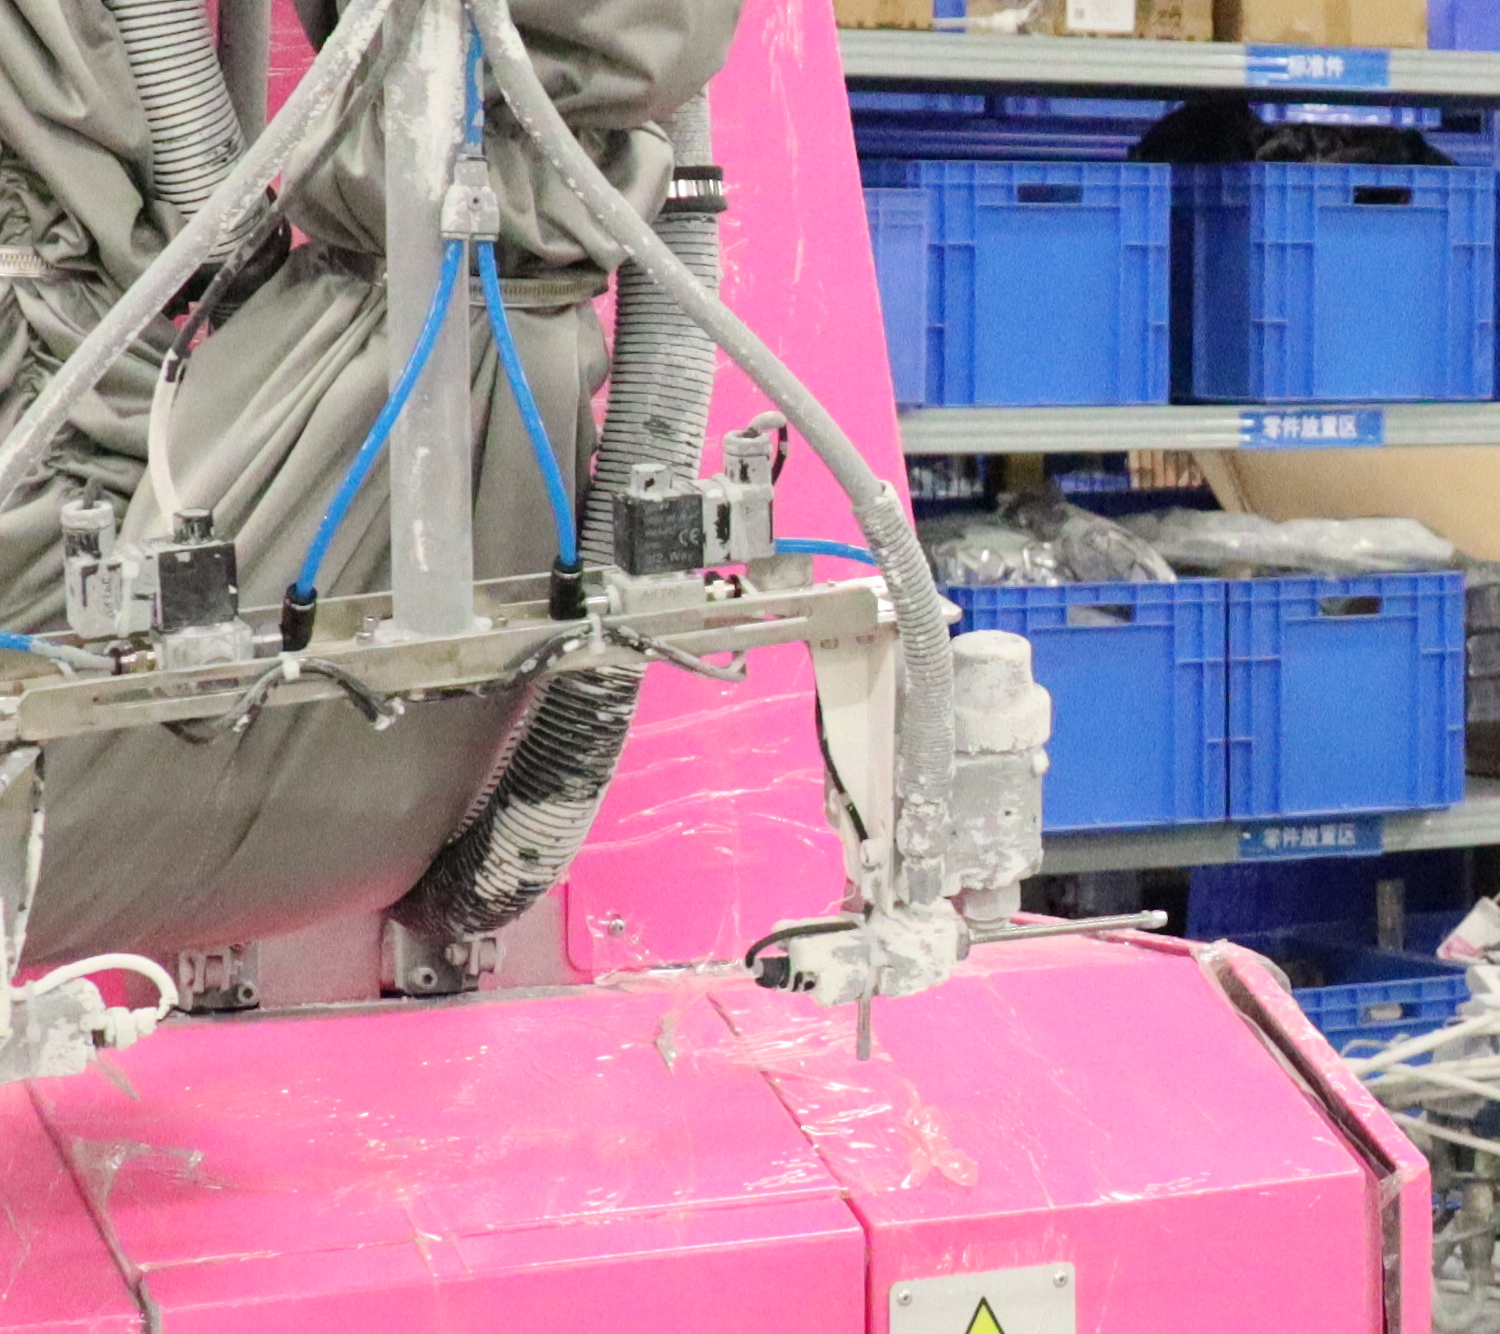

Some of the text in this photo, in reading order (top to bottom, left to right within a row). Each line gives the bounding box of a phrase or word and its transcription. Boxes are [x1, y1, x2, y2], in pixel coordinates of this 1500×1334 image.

[1262, 415, 1358, 440] 零件放置区
[1262, 822, 1356, 850] 零件放置区
